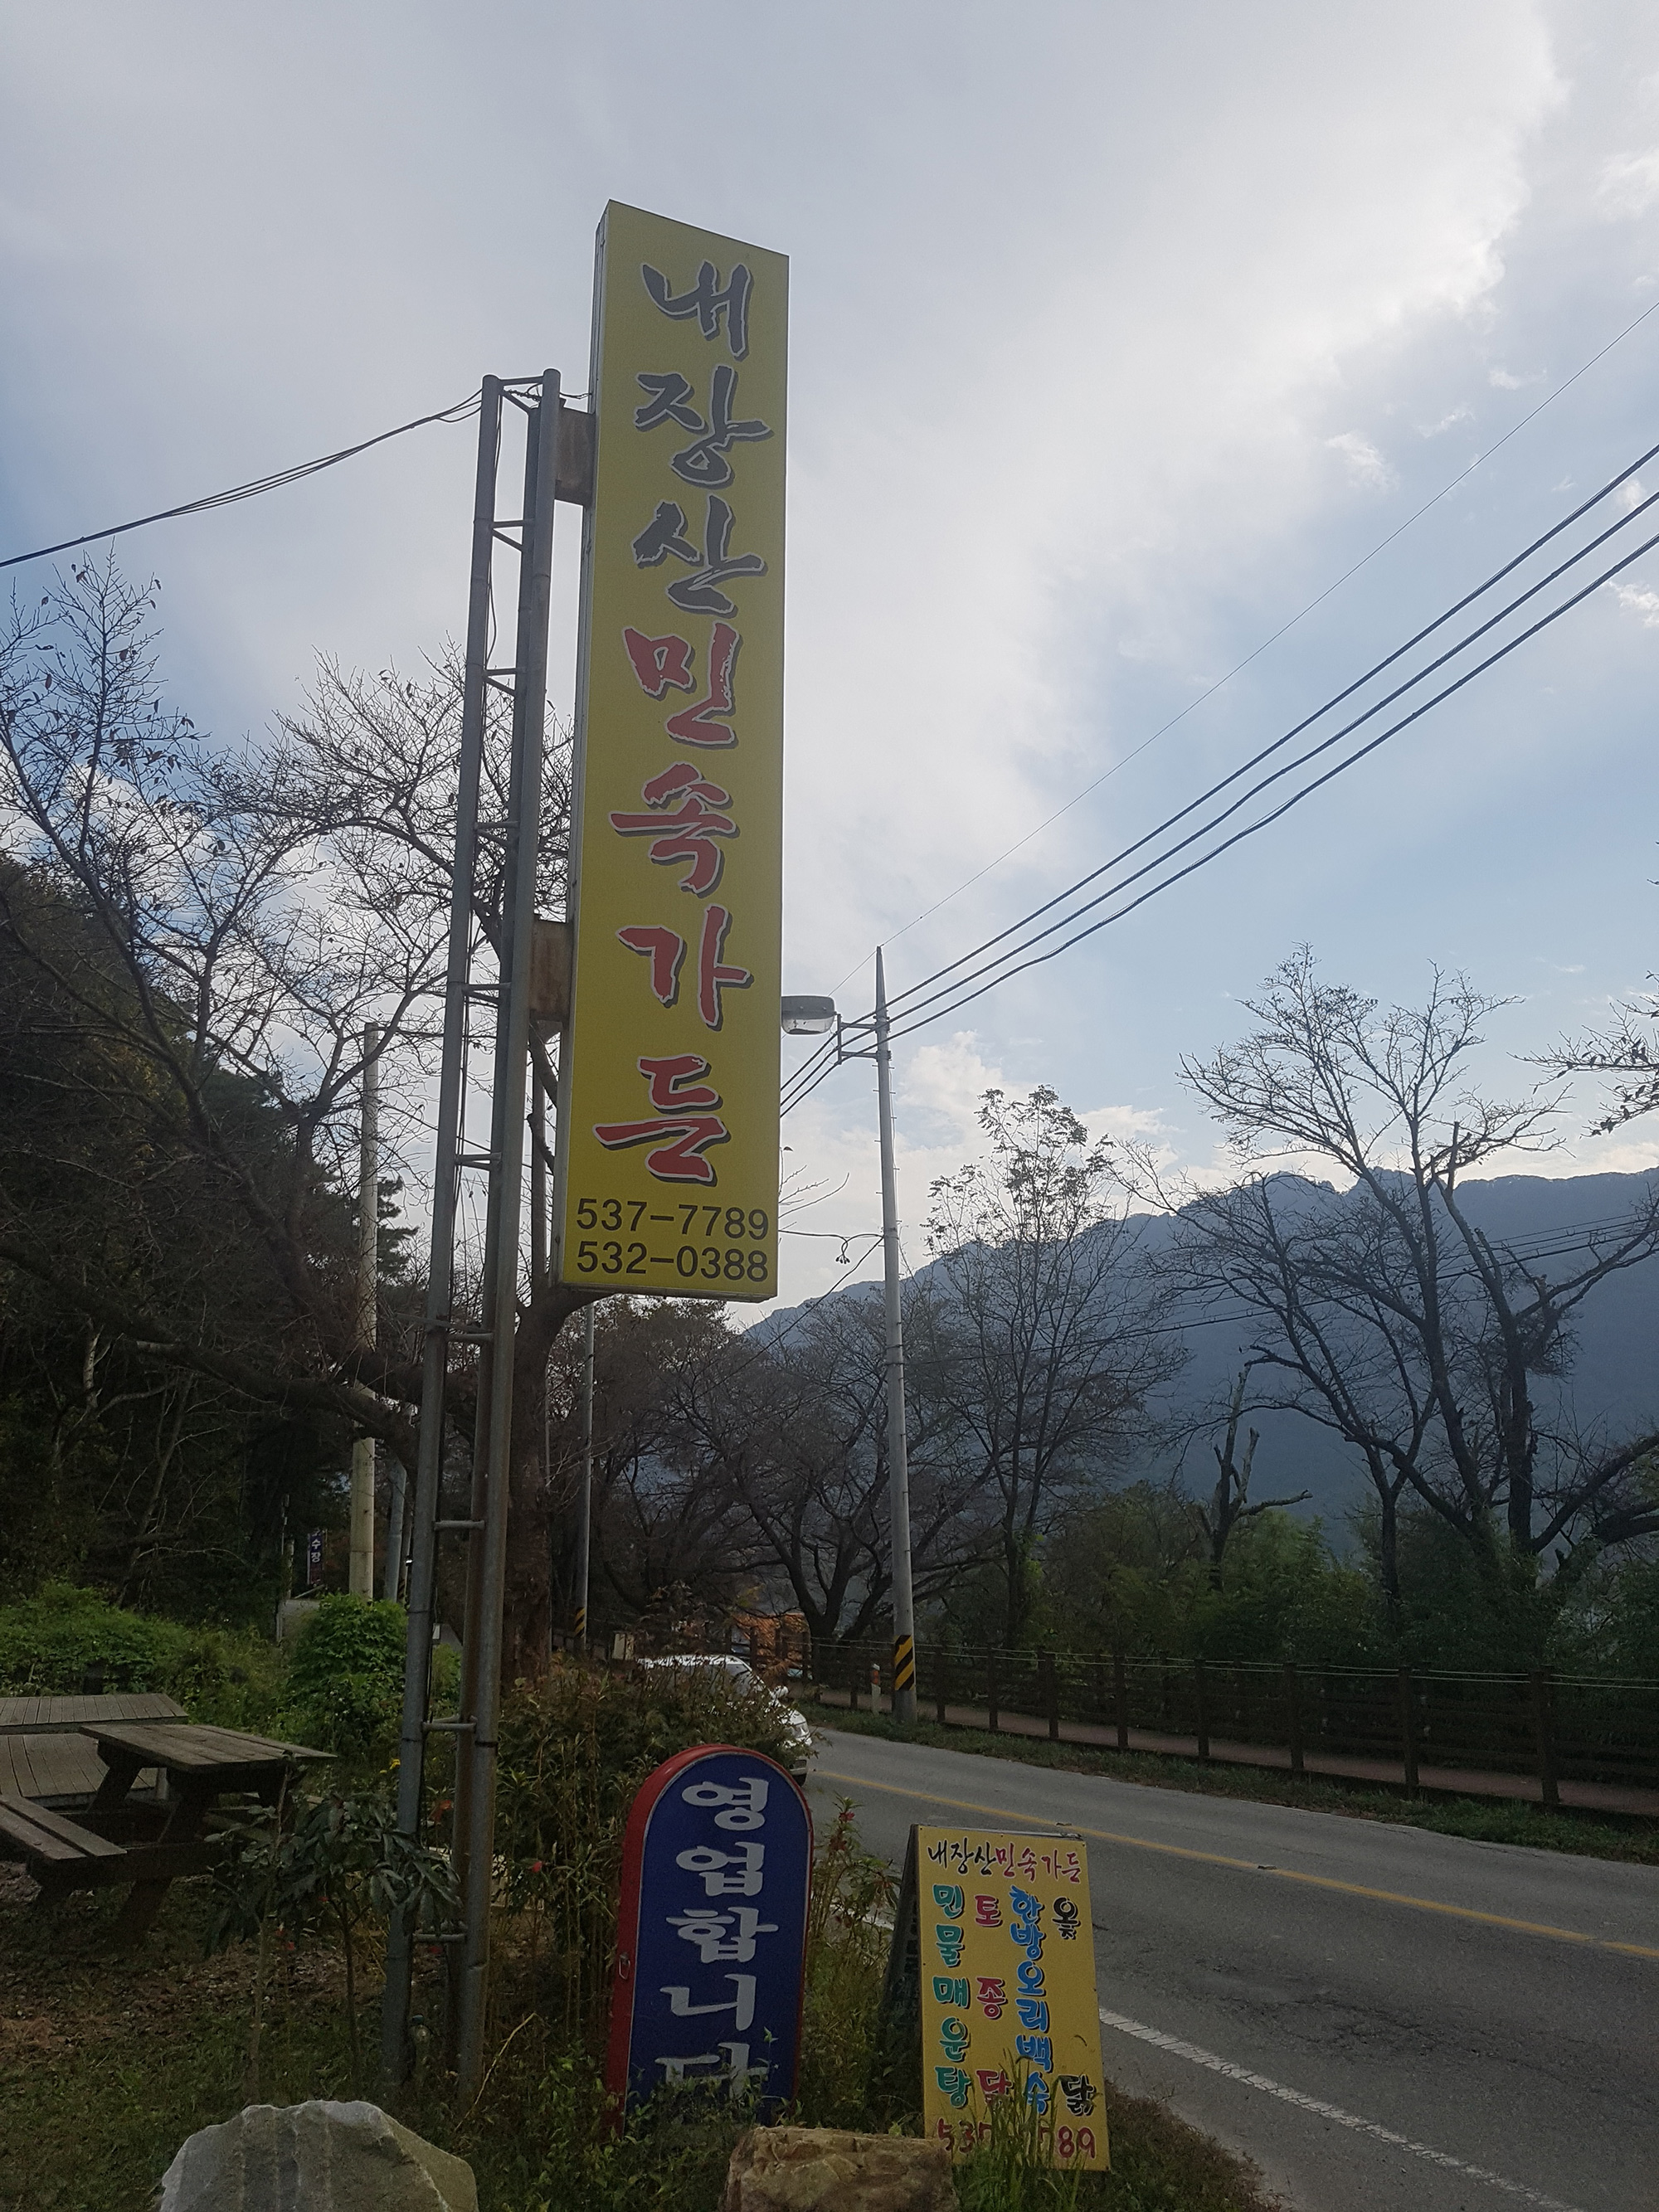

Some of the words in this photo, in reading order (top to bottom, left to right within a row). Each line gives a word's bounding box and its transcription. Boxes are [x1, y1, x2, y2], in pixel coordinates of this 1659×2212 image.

[577, 1198, 769, 1241] 537-7789
[577, 1240, 769, 1282] 532-0388
[654, 1777, 780, 2099] 영업합니다
[932, 1884, 971, 2107] 민물매운탕
